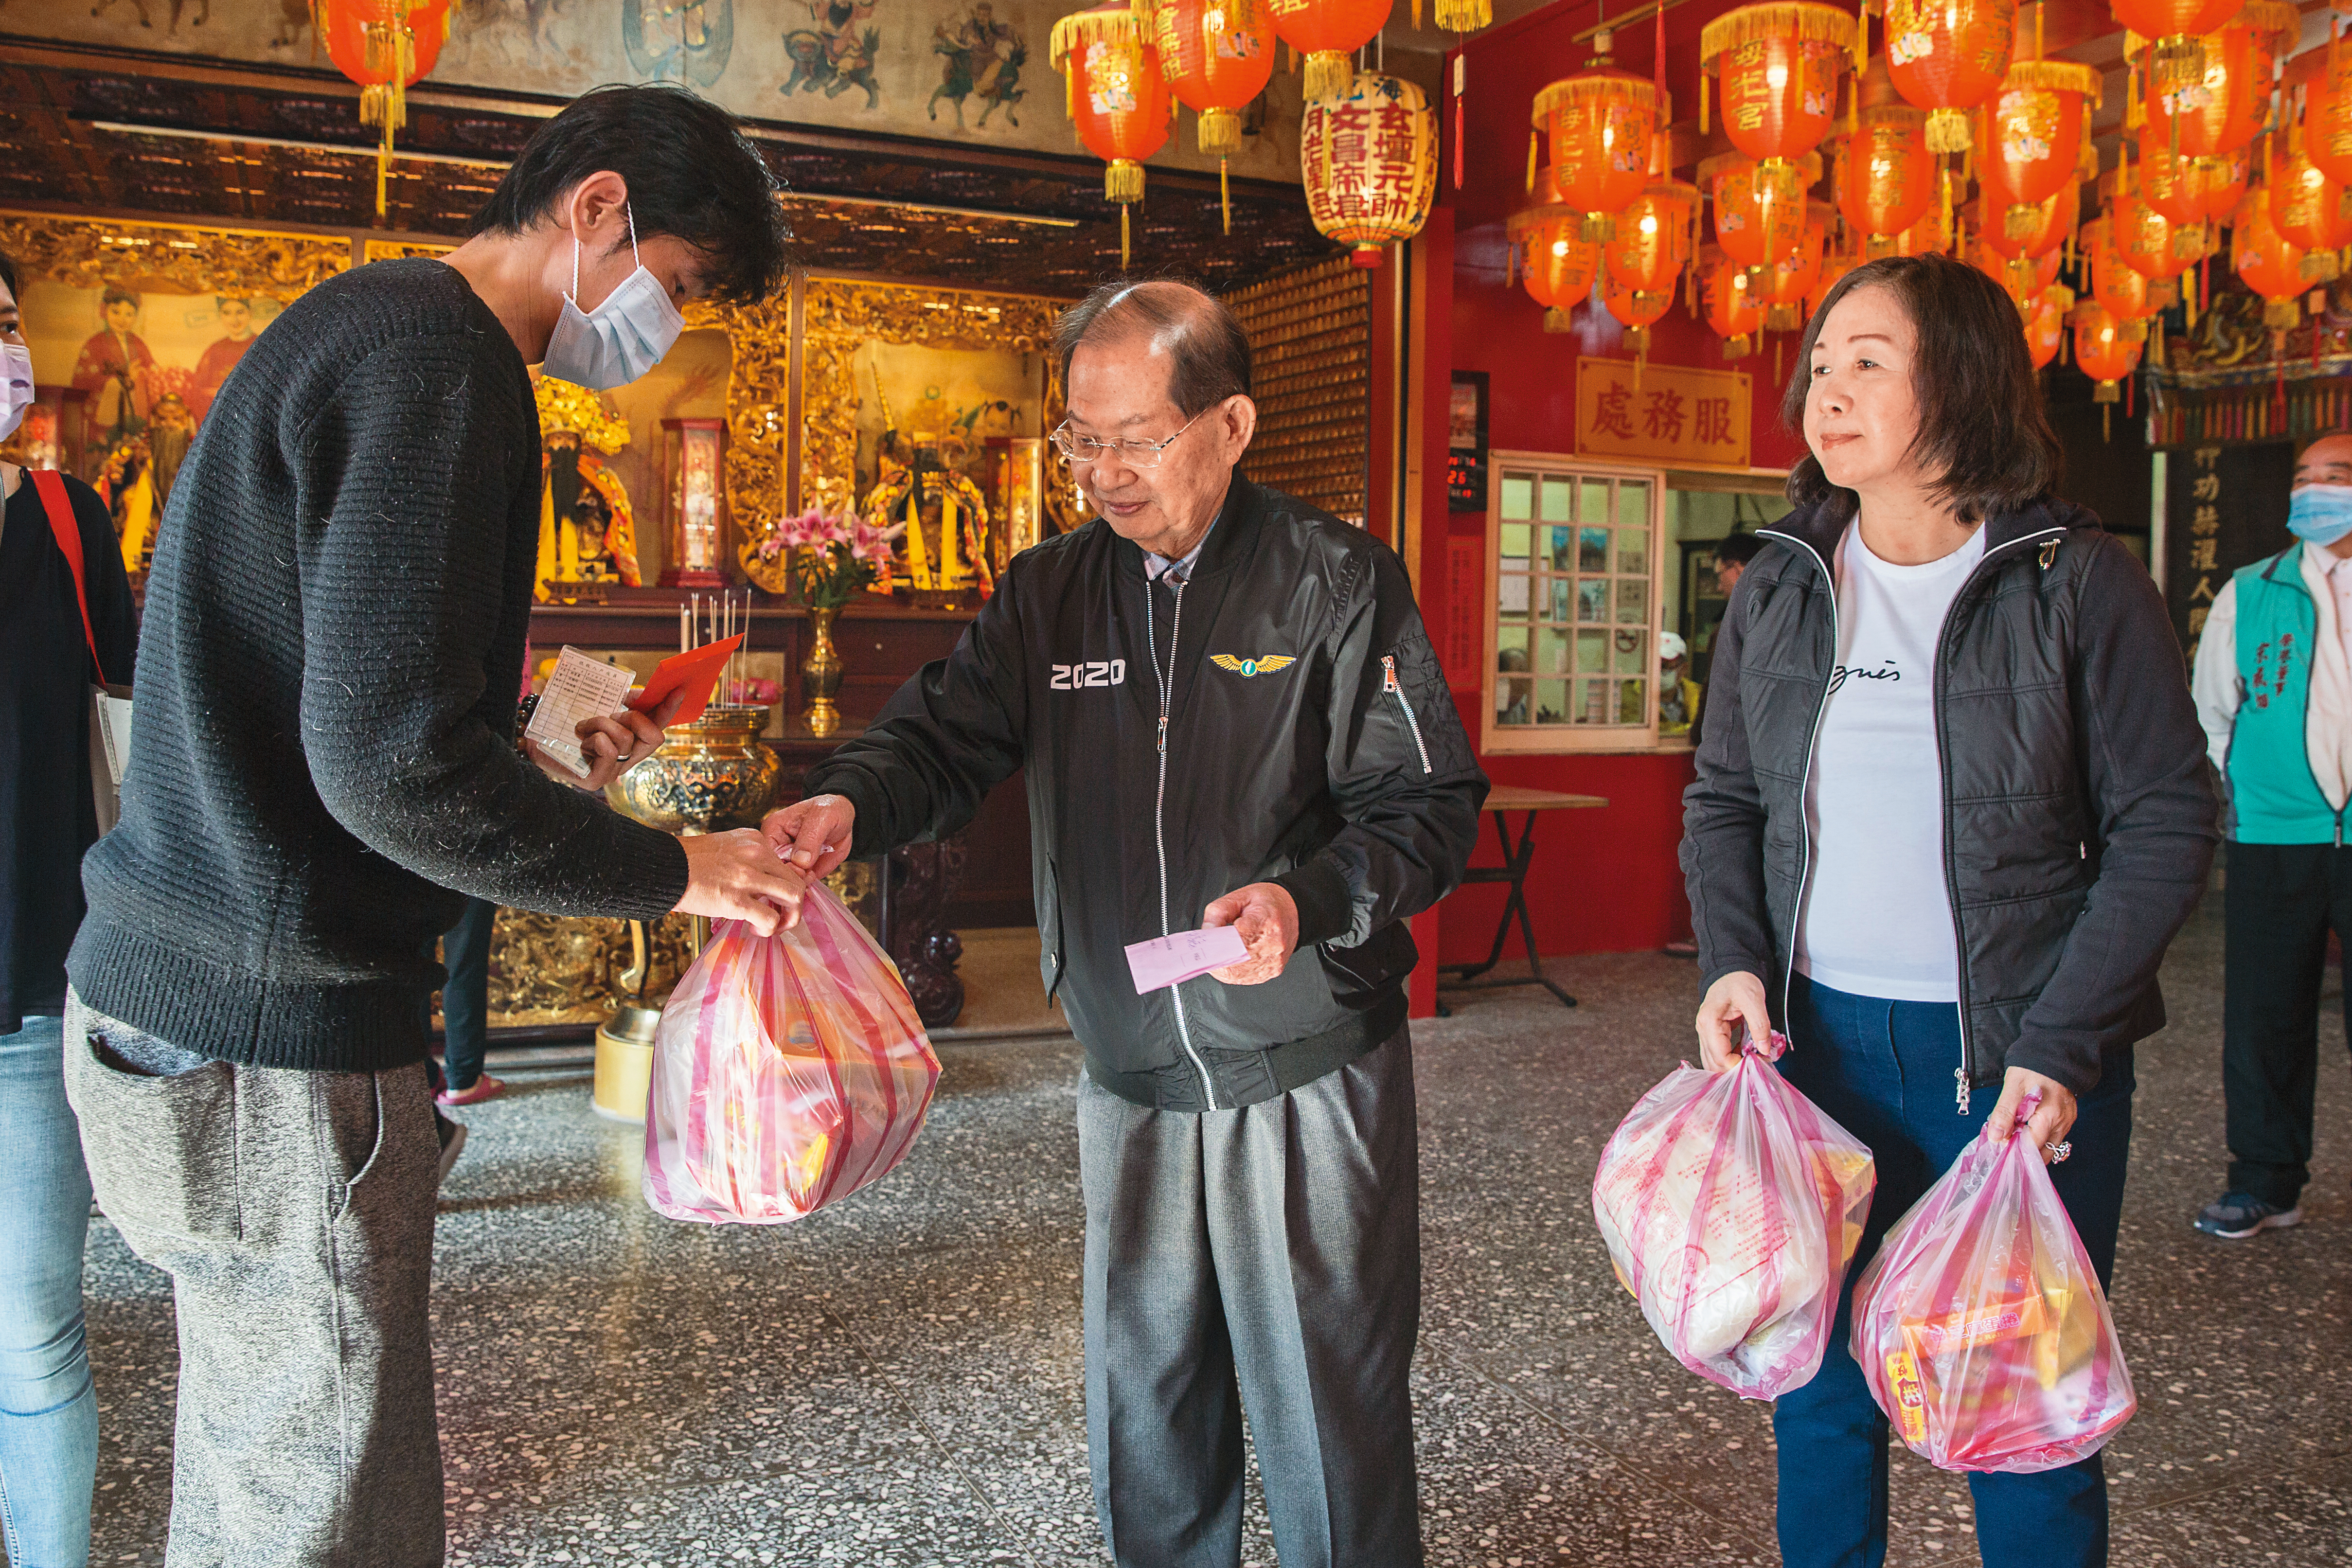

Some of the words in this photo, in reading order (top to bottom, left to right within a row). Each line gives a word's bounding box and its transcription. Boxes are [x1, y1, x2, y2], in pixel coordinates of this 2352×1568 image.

[1729, 38, 1769, 131] 海光宮
[1331, 103, 1370, 219] 文昌帝君
[1373, 102, 1417, 220] 玄壇元帥
[1050, 659, 1125, 690] 2020
